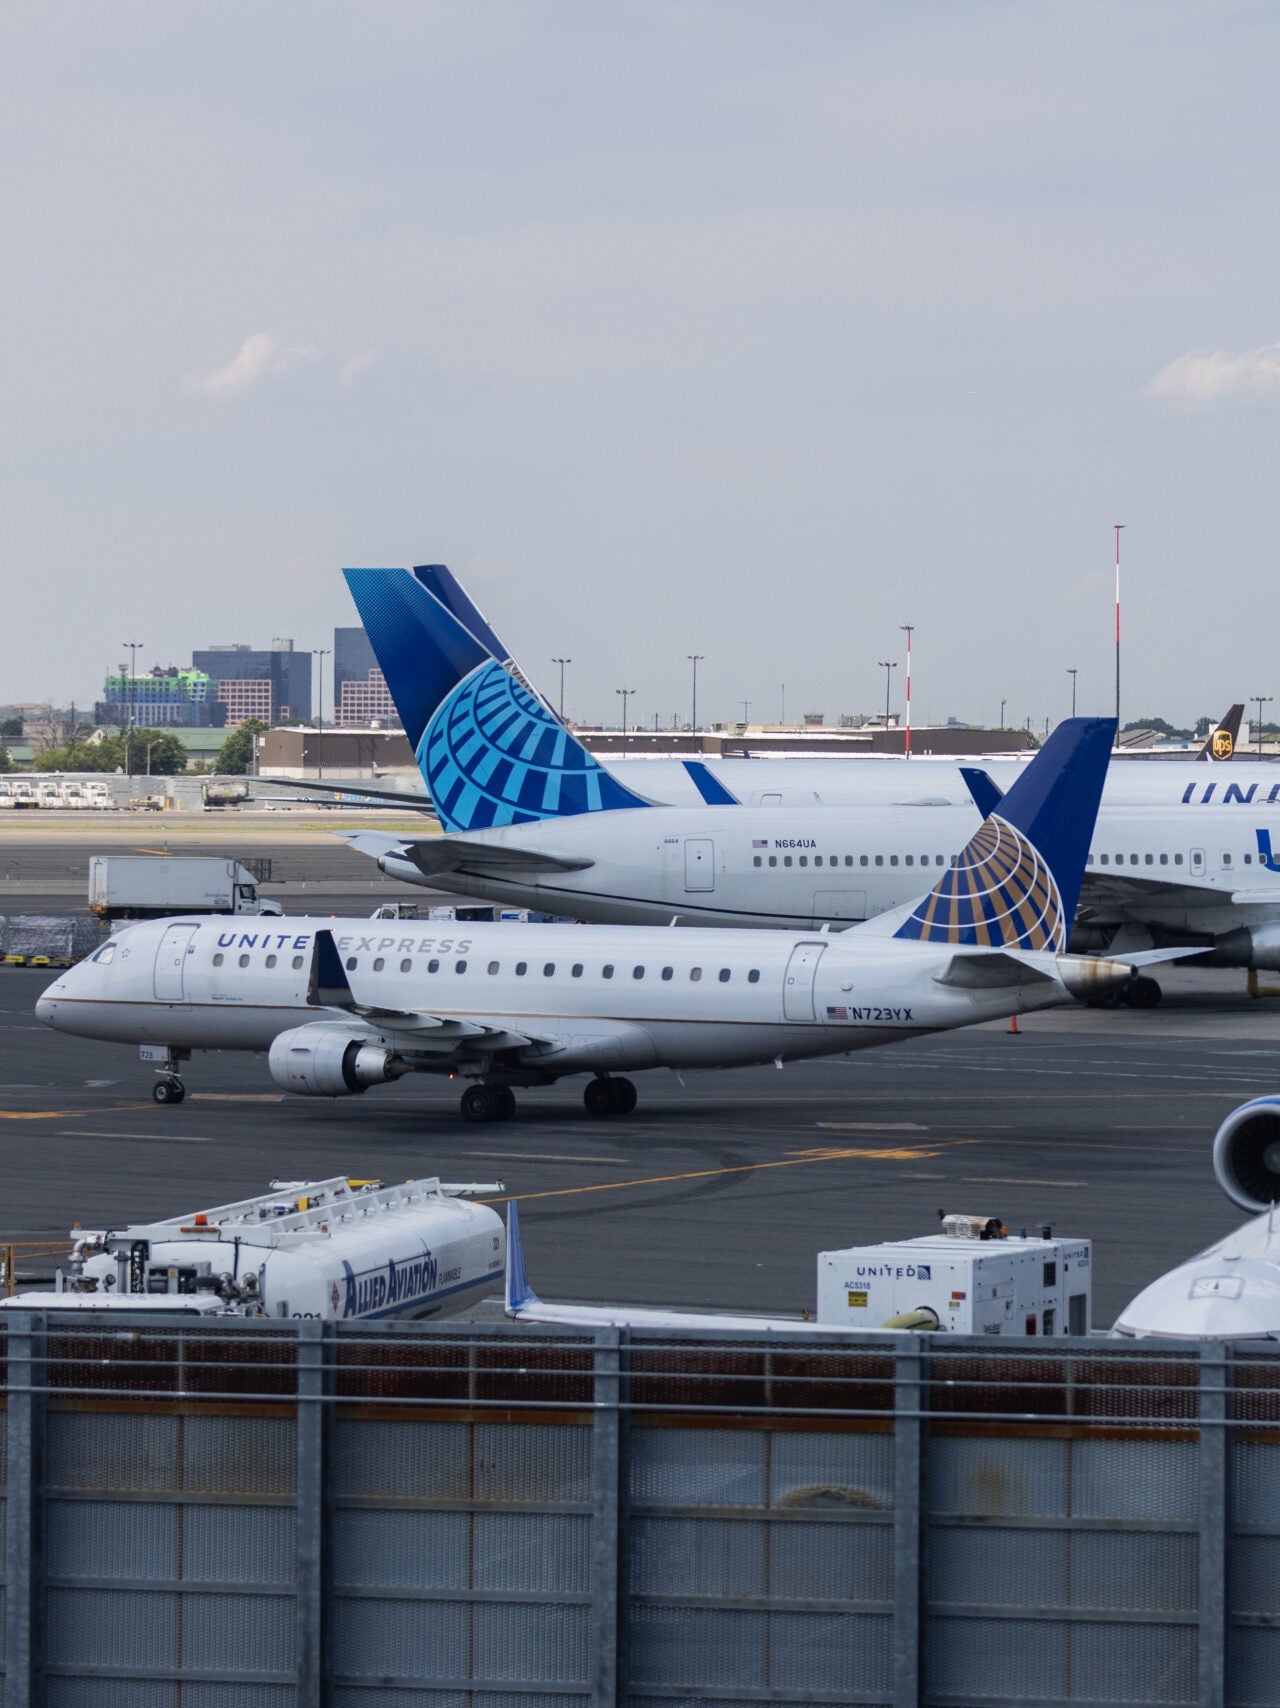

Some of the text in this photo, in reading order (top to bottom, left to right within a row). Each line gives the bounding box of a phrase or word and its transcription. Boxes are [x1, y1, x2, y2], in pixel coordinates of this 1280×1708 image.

[1214, 739, 1232, 756] ups
[775, 839, 817, 849] N664UA
[217, 933, 472, 955] UNITE EXPRESS
[853, 1007, 914, 1021] N723YX
[141, 1051, 154, 1059] 723
[857, 1267, 916, 1277] UNITED
[342, 1260, 386, 1318] ALLIED
[387, 1258, 437, 1304] AVIATION
